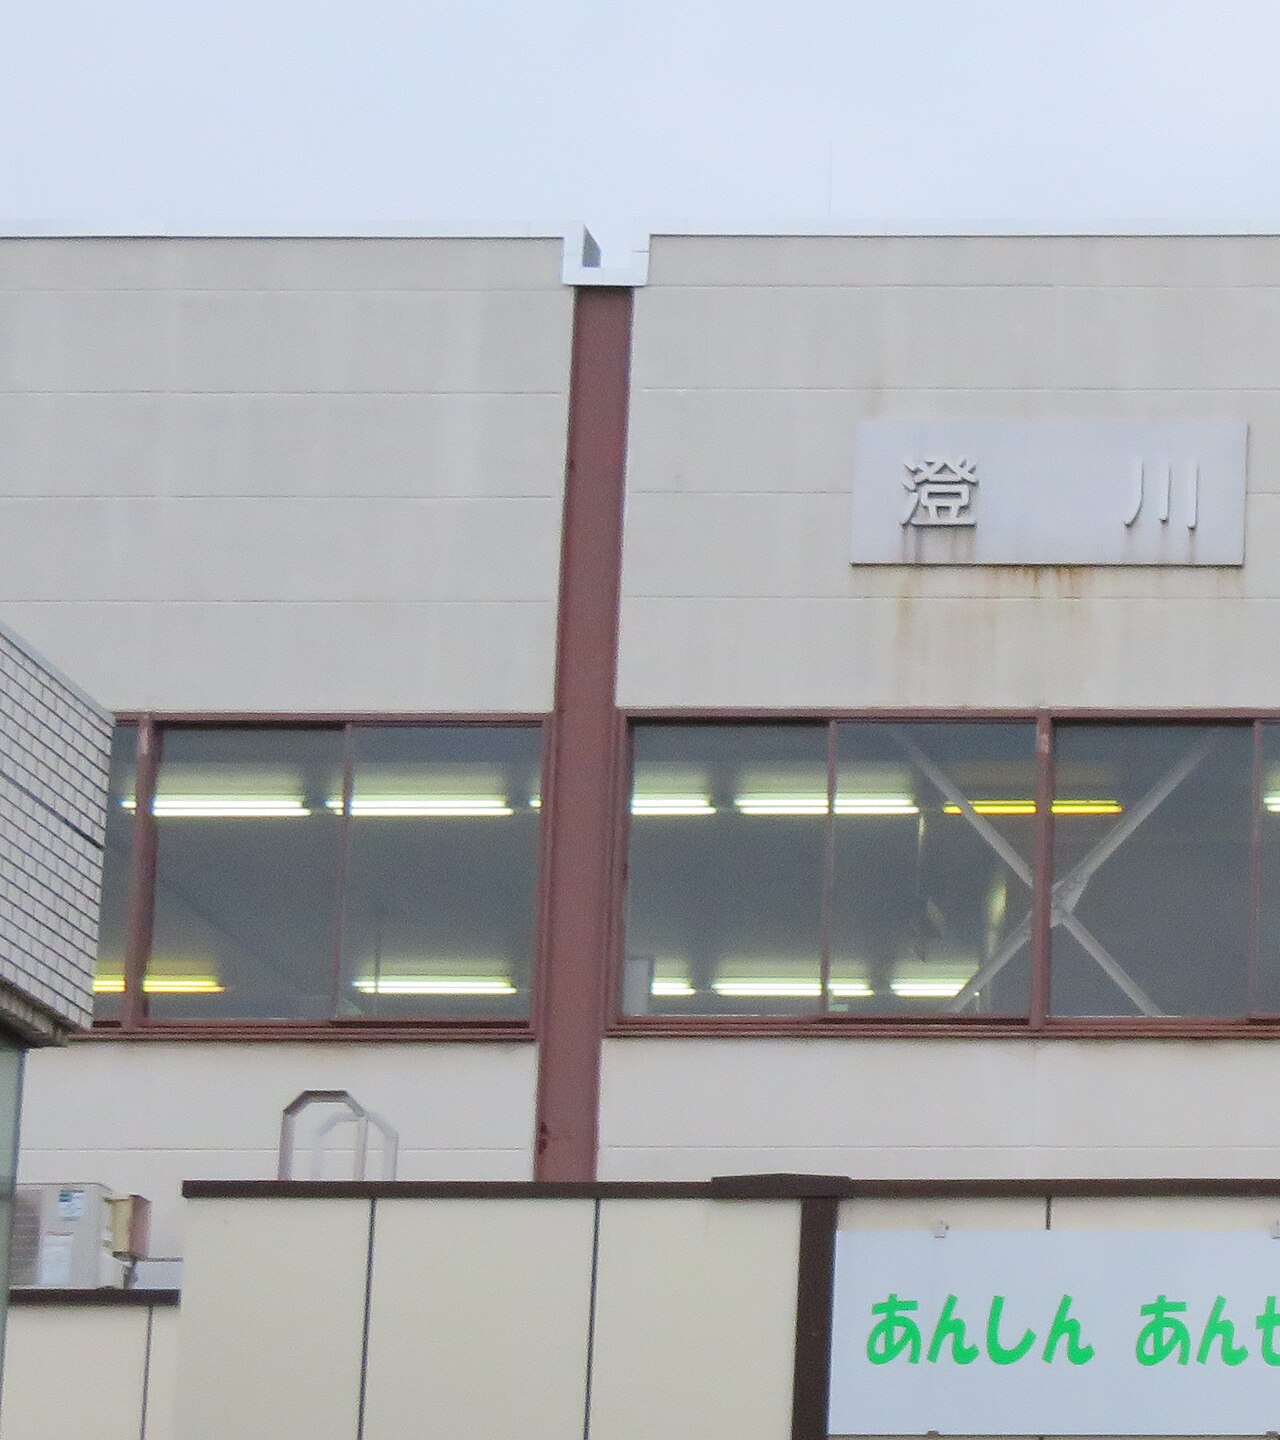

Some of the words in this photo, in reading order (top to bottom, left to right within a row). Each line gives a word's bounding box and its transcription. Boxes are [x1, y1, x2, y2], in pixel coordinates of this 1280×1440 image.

[900, 457, 1198, 531] 澄川
[868, 1294, 1094, 1366] あんしん
